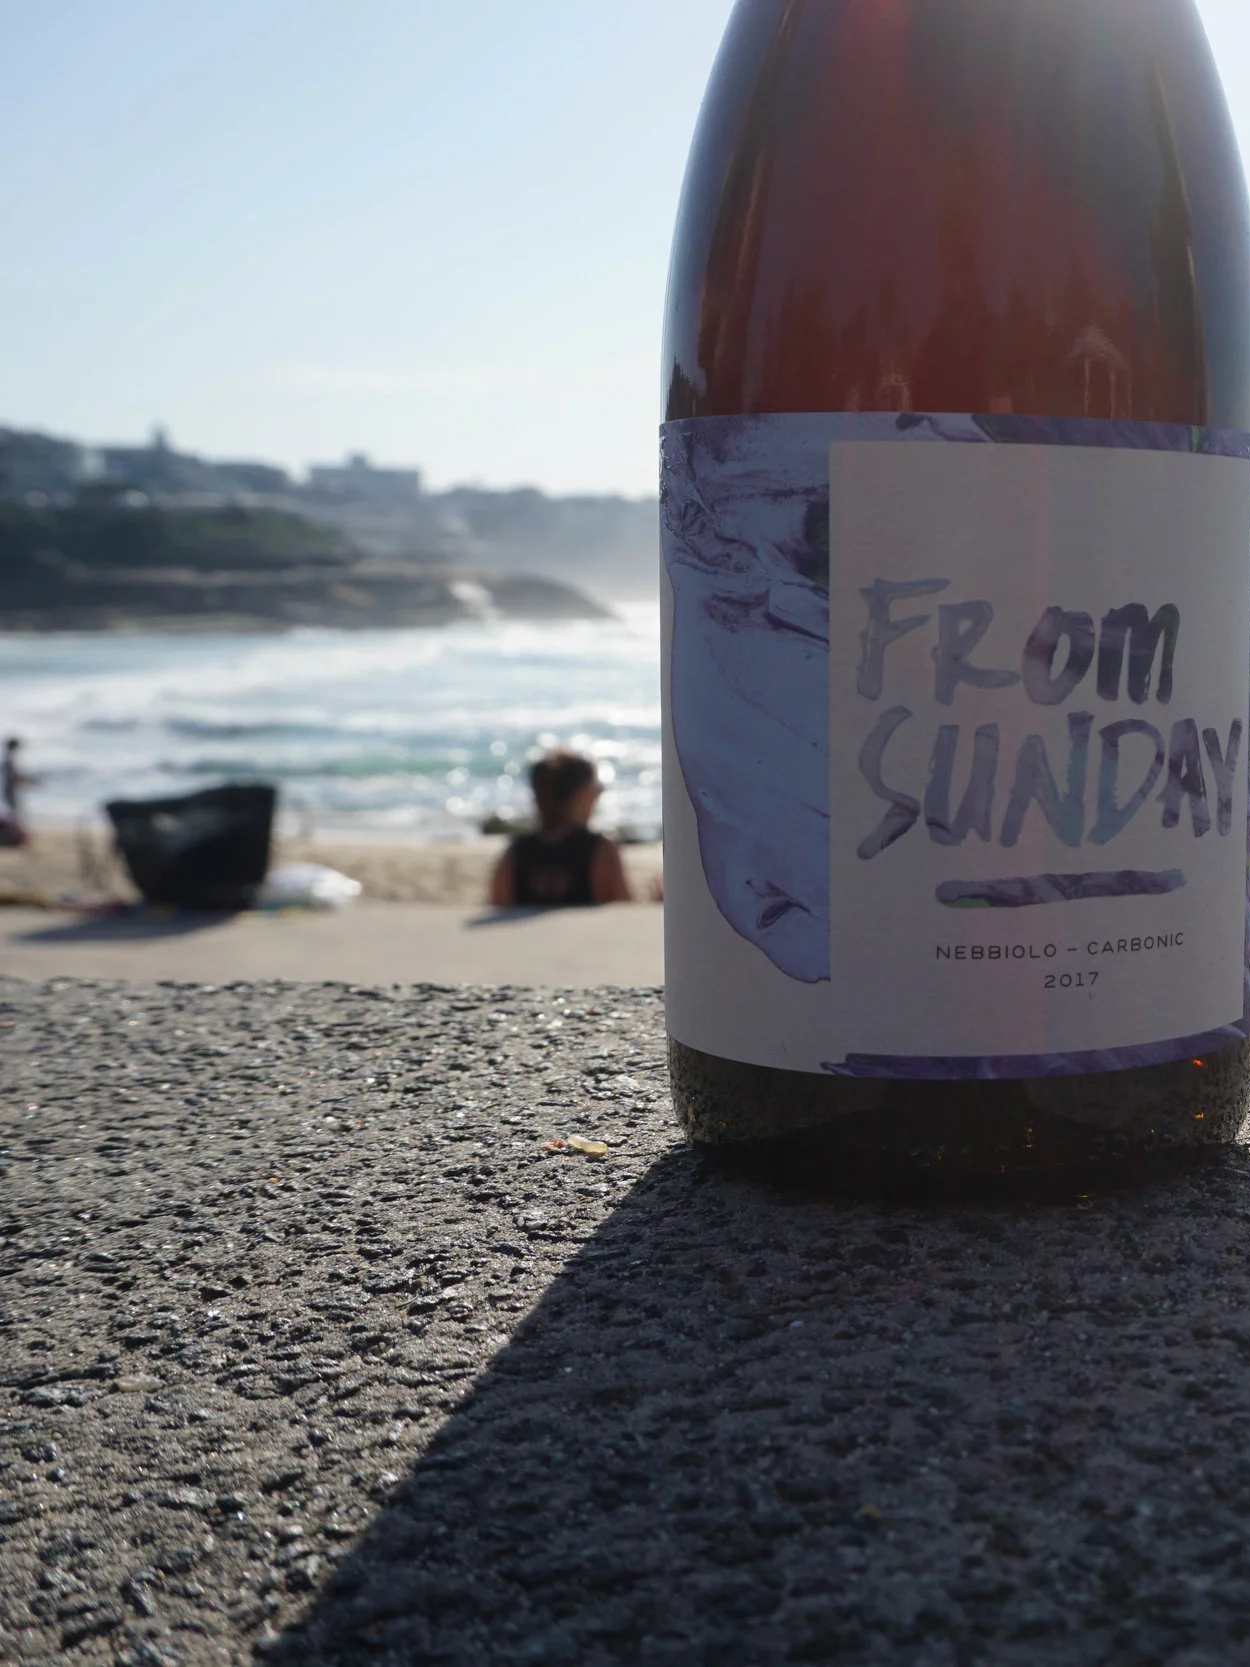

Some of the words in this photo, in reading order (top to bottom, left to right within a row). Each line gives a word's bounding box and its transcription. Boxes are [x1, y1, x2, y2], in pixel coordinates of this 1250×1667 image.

[857, 706, 1243, 860] SUNDAY
[936, 943, 1057, 960] NEBBIOLO
[1087, 932, 1185, 956] CARBONIC
[1044, 972, 1099, 989] 2017
